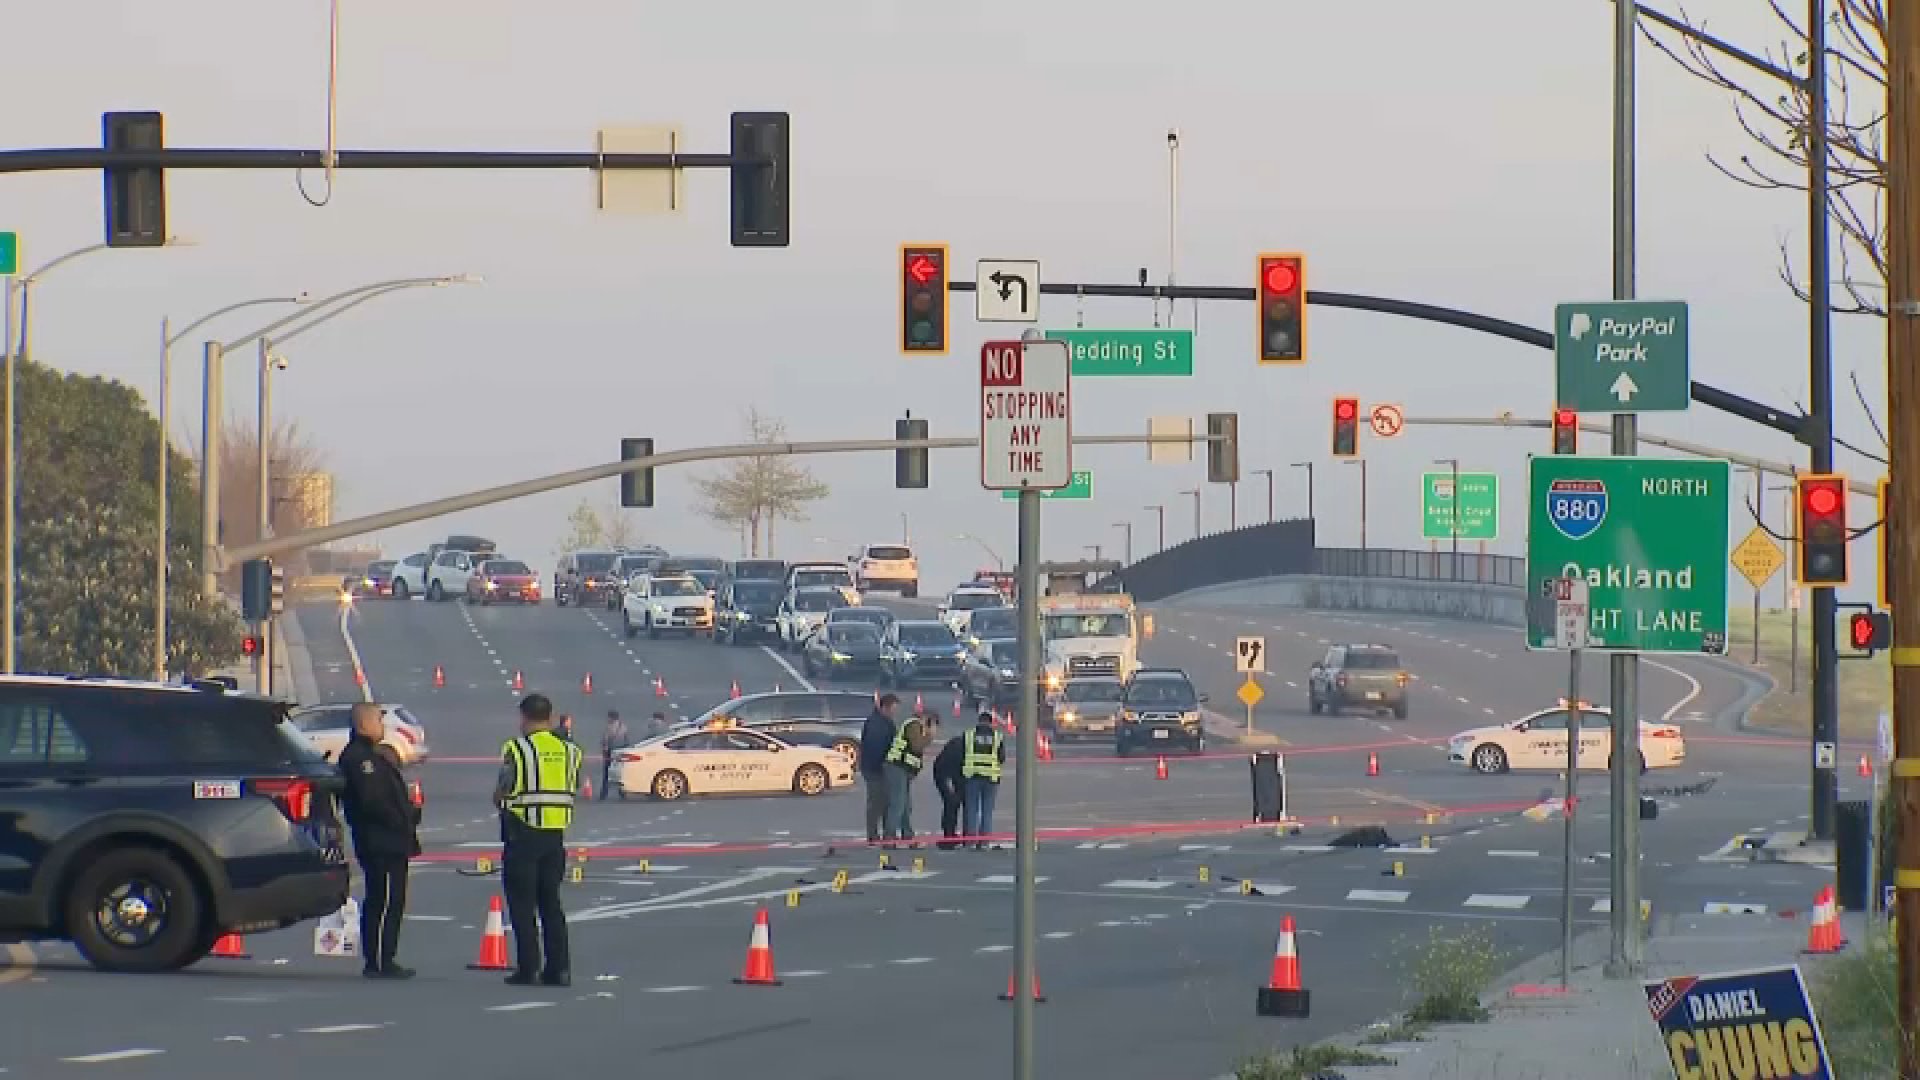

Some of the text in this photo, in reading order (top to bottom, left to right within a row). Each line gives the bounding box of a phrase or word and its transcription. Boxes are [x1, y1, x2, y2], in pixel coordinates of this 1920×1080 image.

[1600, 316, 1675, 339] PayPal
[986, 347, 1018, 380] NO
[1070, 340, 1176, 366] edding St
[1597, 342, 1648, 362] Park
[986, 391, 1065, 419] STOPPING
[1010, 425, 1041, 446] ANY
[1008, 452, 1044, 472] TIME
[1642, 478, 1708, 496] NORTH
[1554, 499, 1600, 520] 880
[1637, 609, 1703, 632] LANE
[1687, 988, 1766, 1021] DANIEL
[1670, 1018, 1820, 1080] CHUNG
